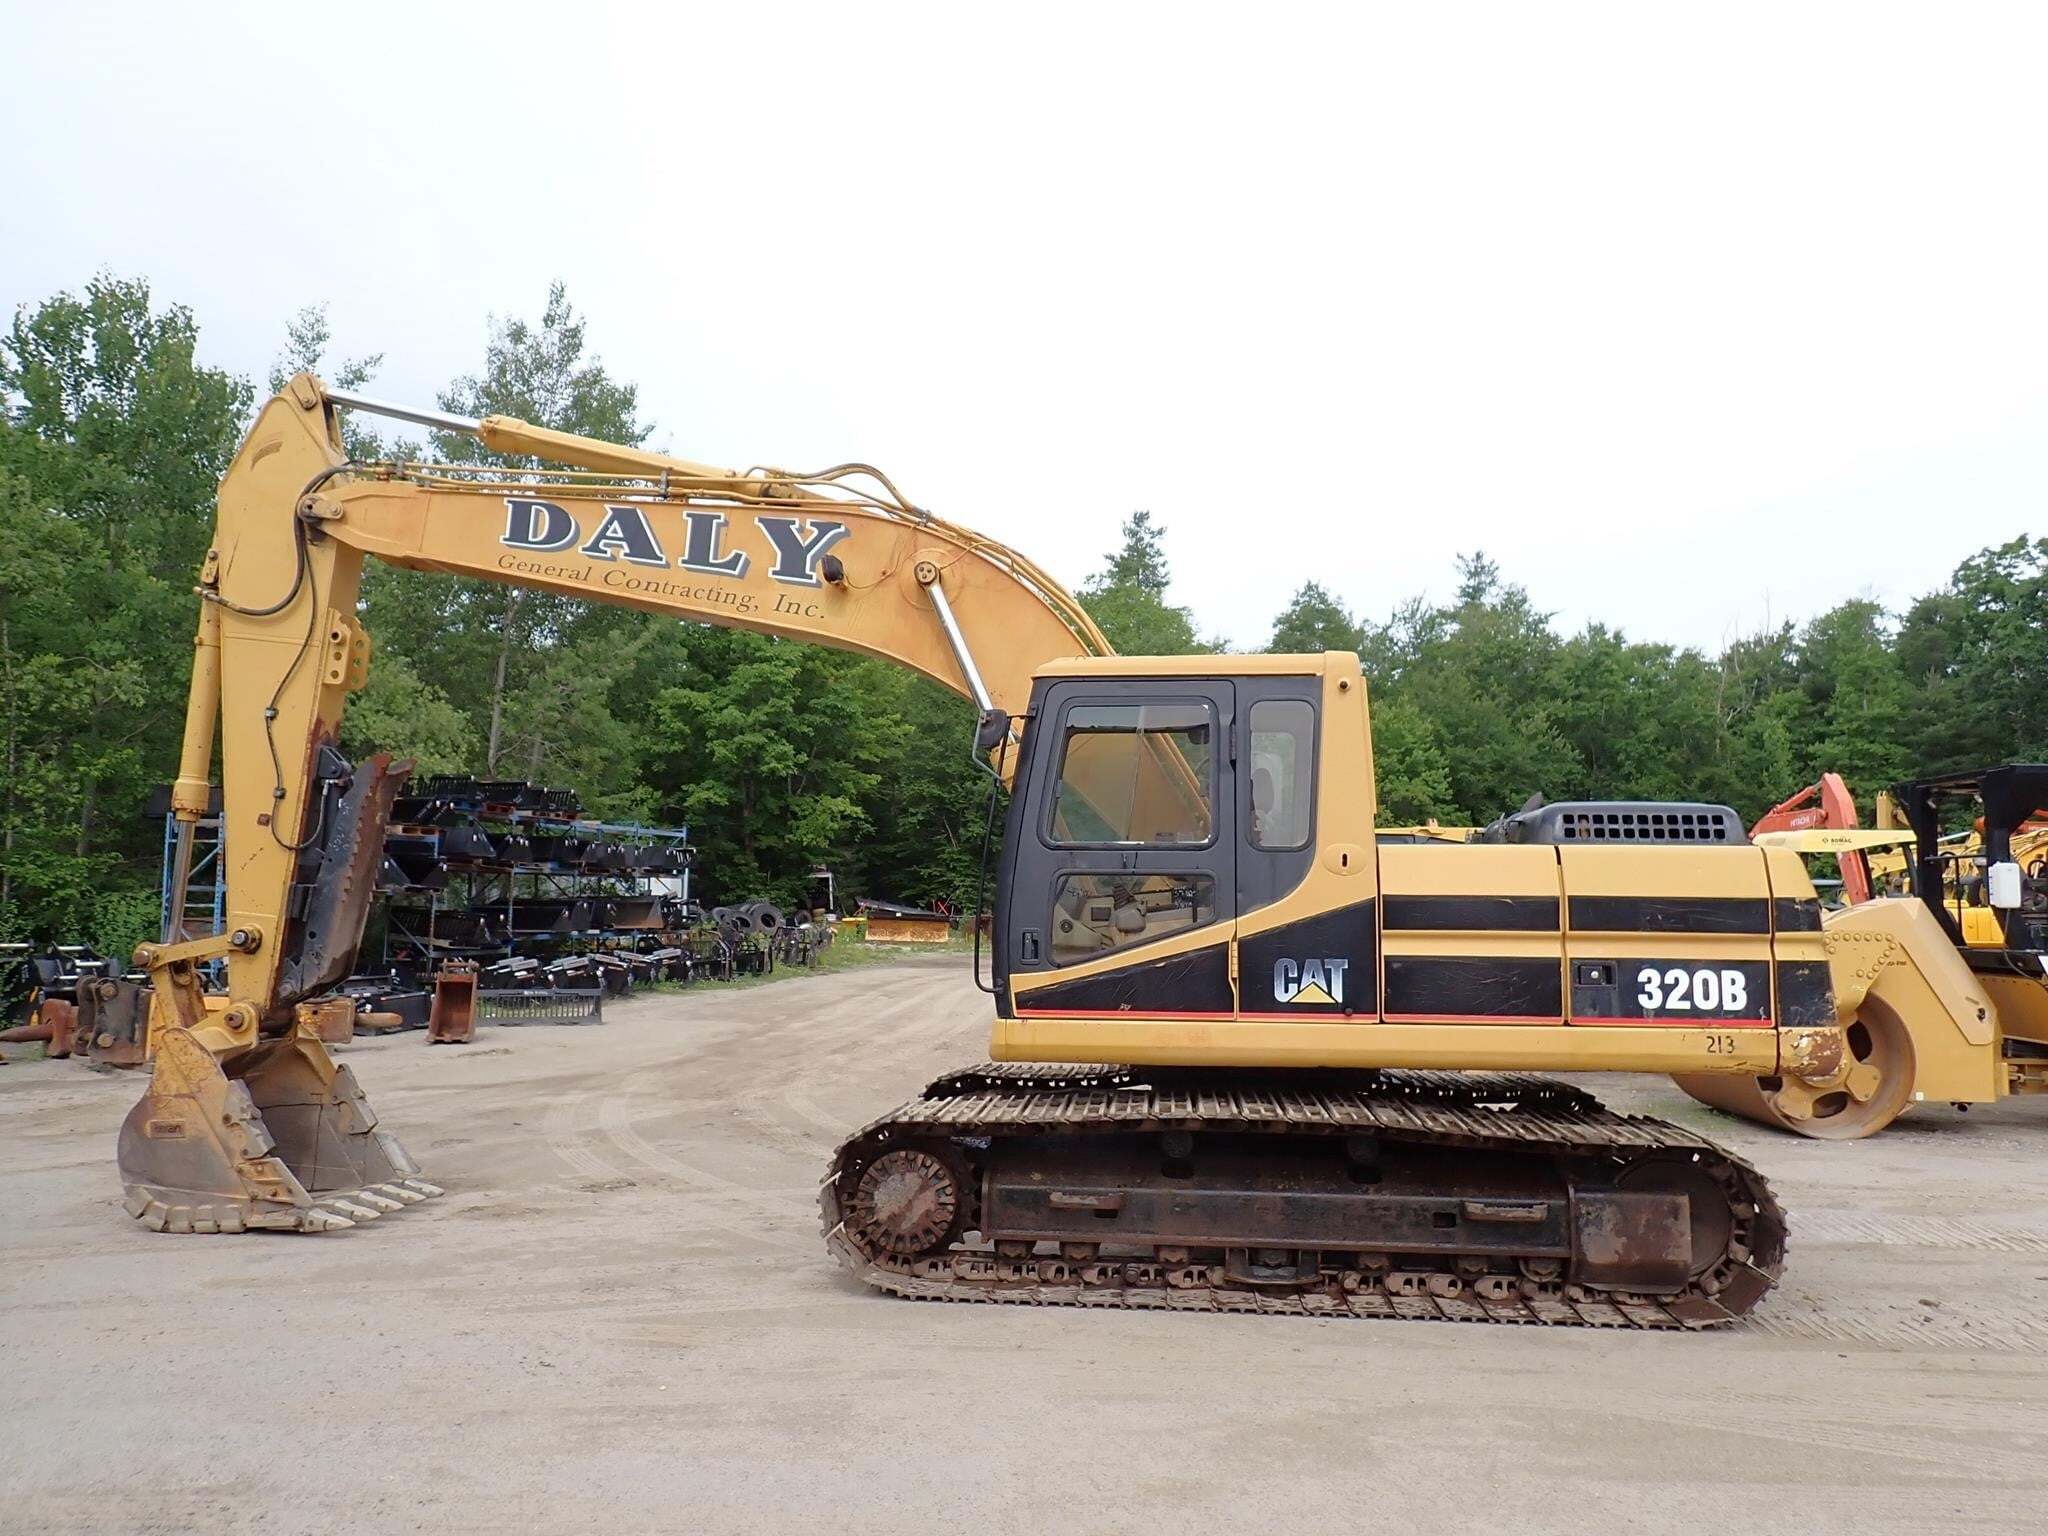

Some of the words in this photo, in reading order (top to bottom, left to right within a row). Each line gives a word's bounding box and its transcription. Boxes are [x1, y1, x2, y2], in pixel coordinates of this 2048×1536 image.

[500, 498, 850, 588] DALY
[498, 553, 592, 582] General
[603, 569, 759, 613] Contracting,
[773, 593, 825, 619] Inc.
[1274, 957, 1349, 1004] CAT
[1637, 968, 1747, 1011] 320B
[1706, 1035, 1735, 1054] 213
